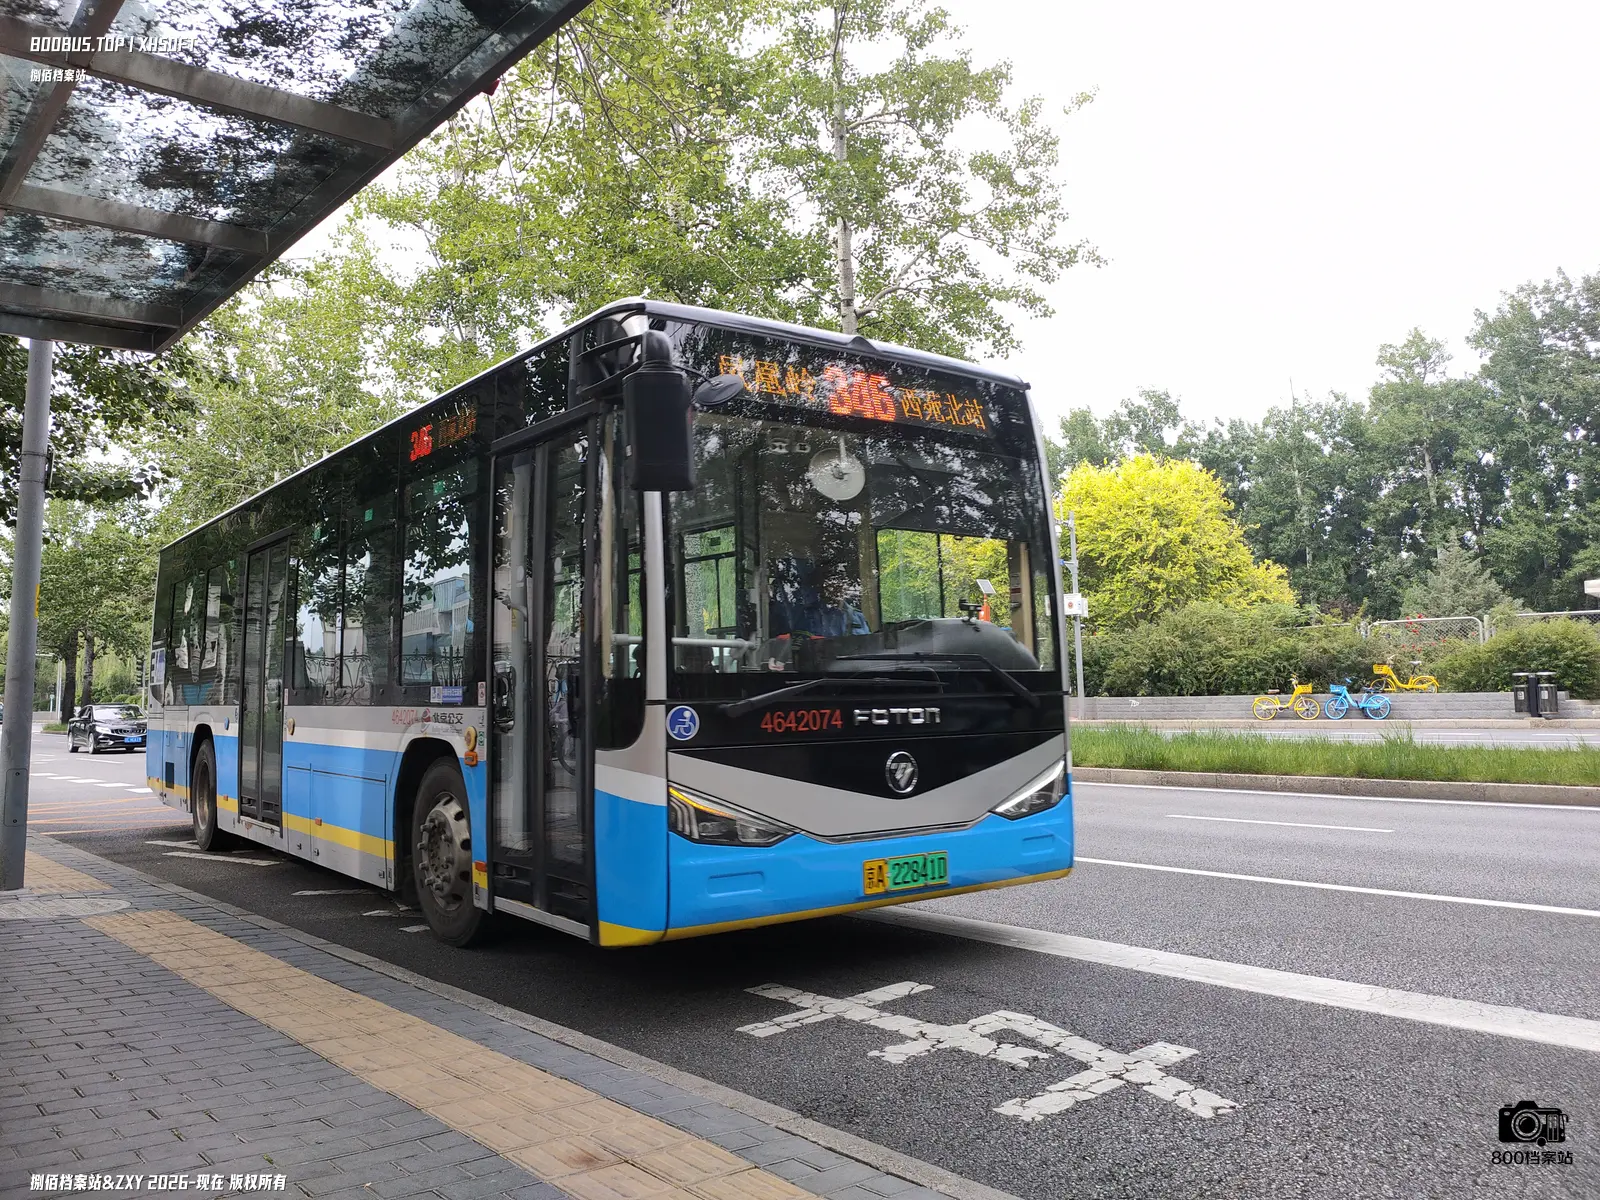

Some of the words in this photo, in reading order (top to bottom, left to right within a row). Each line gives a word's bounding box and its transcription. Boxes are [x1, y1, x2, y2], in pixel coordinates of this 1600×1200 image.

[899, 387, 987, 431] 西苑北站
[760, 709, 843, 733] 4642074
[853, 707, 941, 726] FOTON
